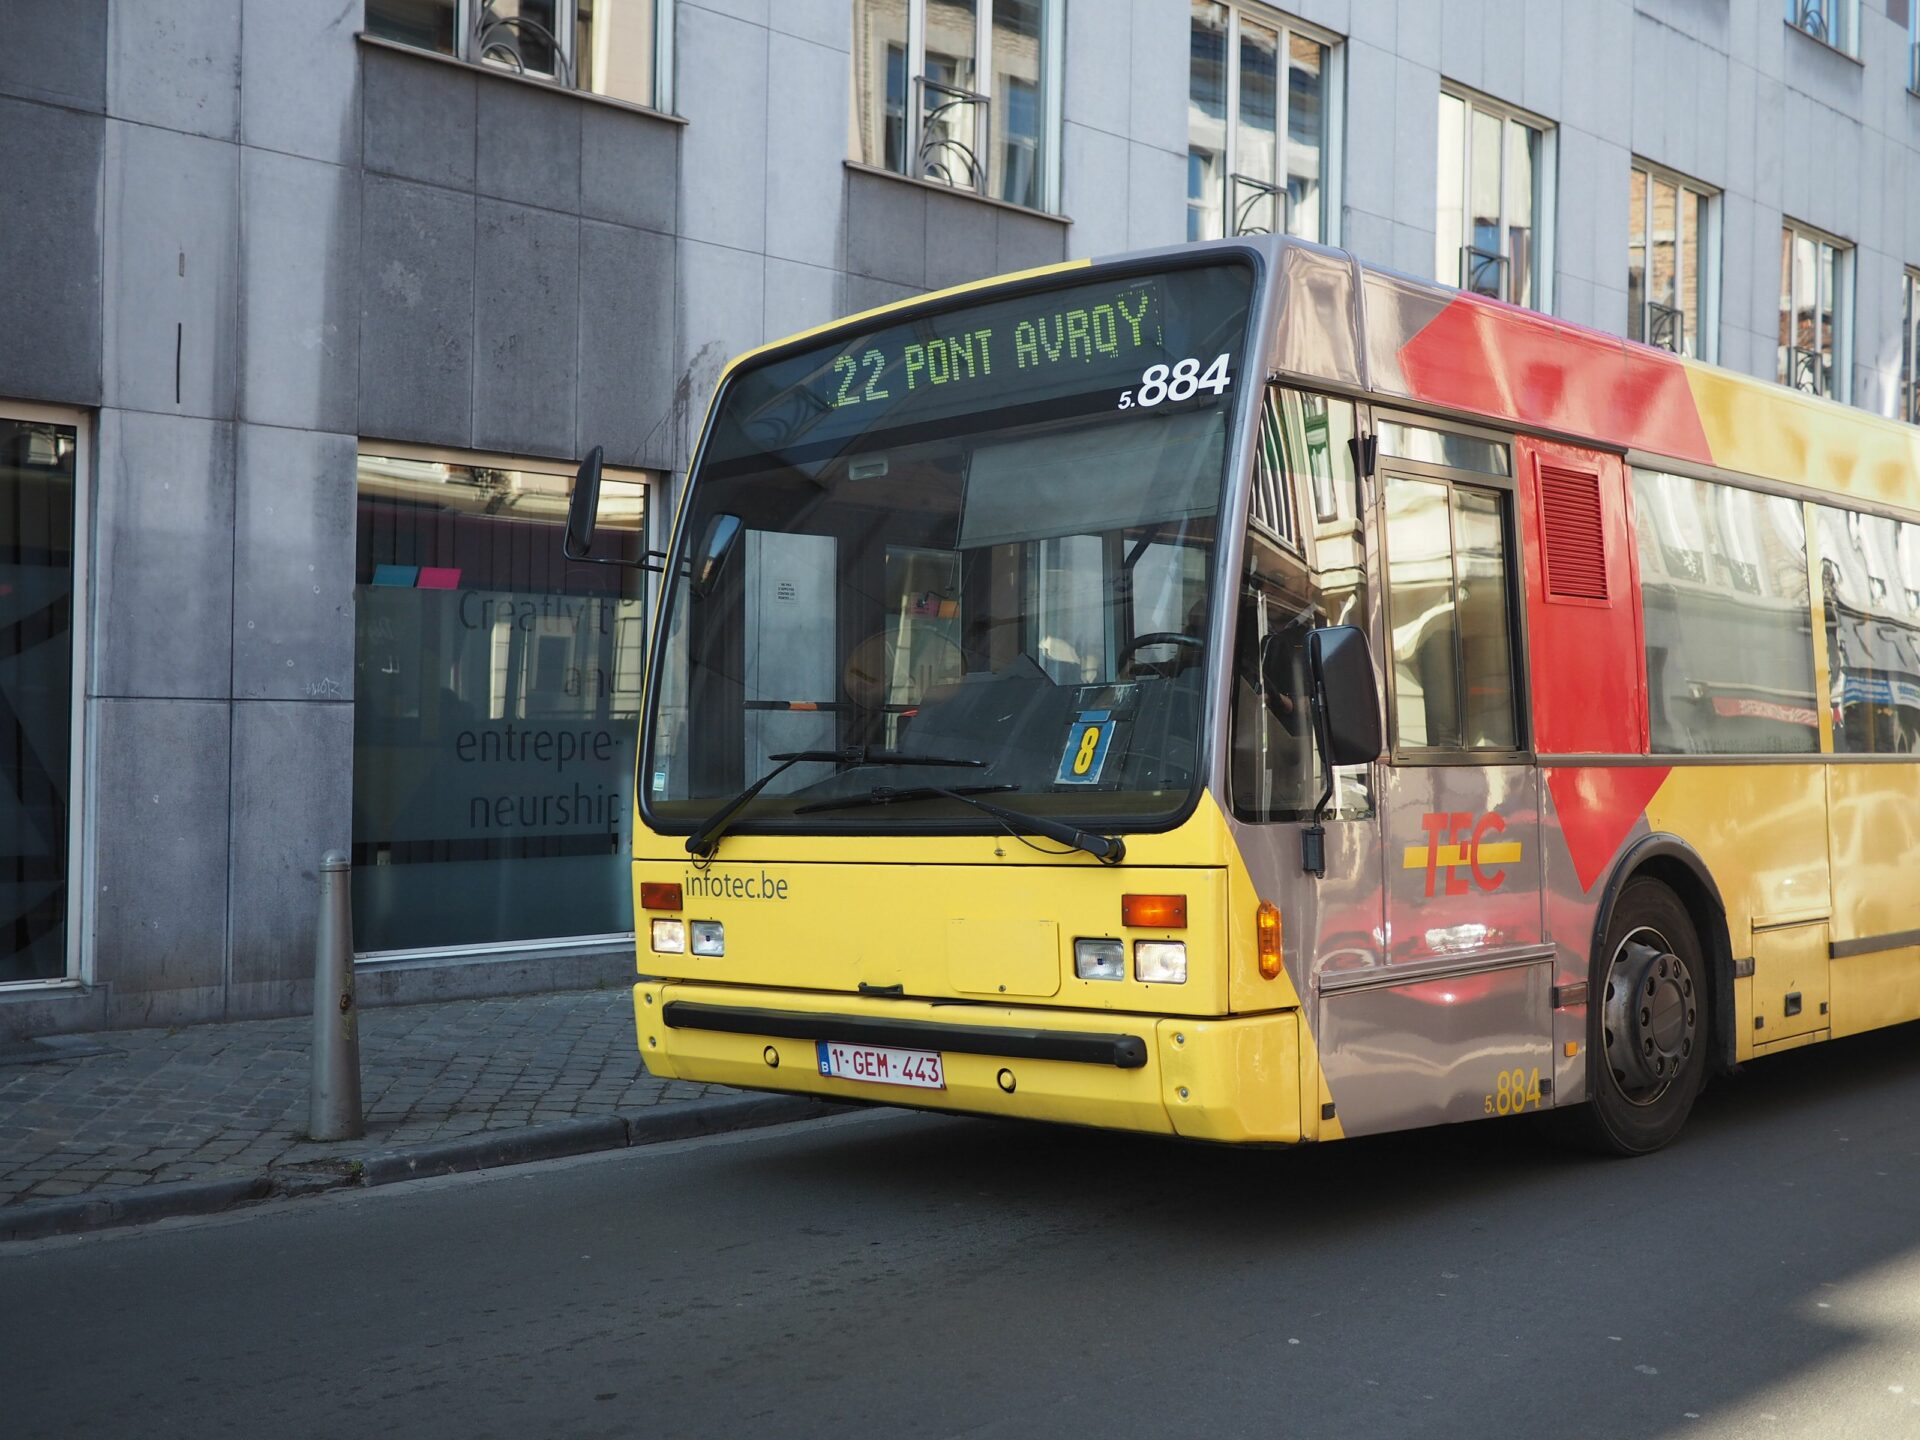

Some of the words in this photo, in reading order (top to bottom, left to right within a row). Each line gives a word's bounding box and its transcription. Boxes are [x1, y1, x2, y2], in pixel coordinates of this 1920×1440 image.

[831, 348, 889, 407] 22
[904, 328, 992, 389] PONT
[1015, 293, 1149, 368] AVROY
[1118, 352, 1231, 410] 5.884
[459, 591, 617, 635] Creativit
[1072, 725, 1101, 776] 8
[1421, 811, 1506, 897] TEC
[685, 870, 789, 900] infotec.be
[821, 1061, 829, 1073] B
[1484, 1067, 1541, 1115] 5.884
